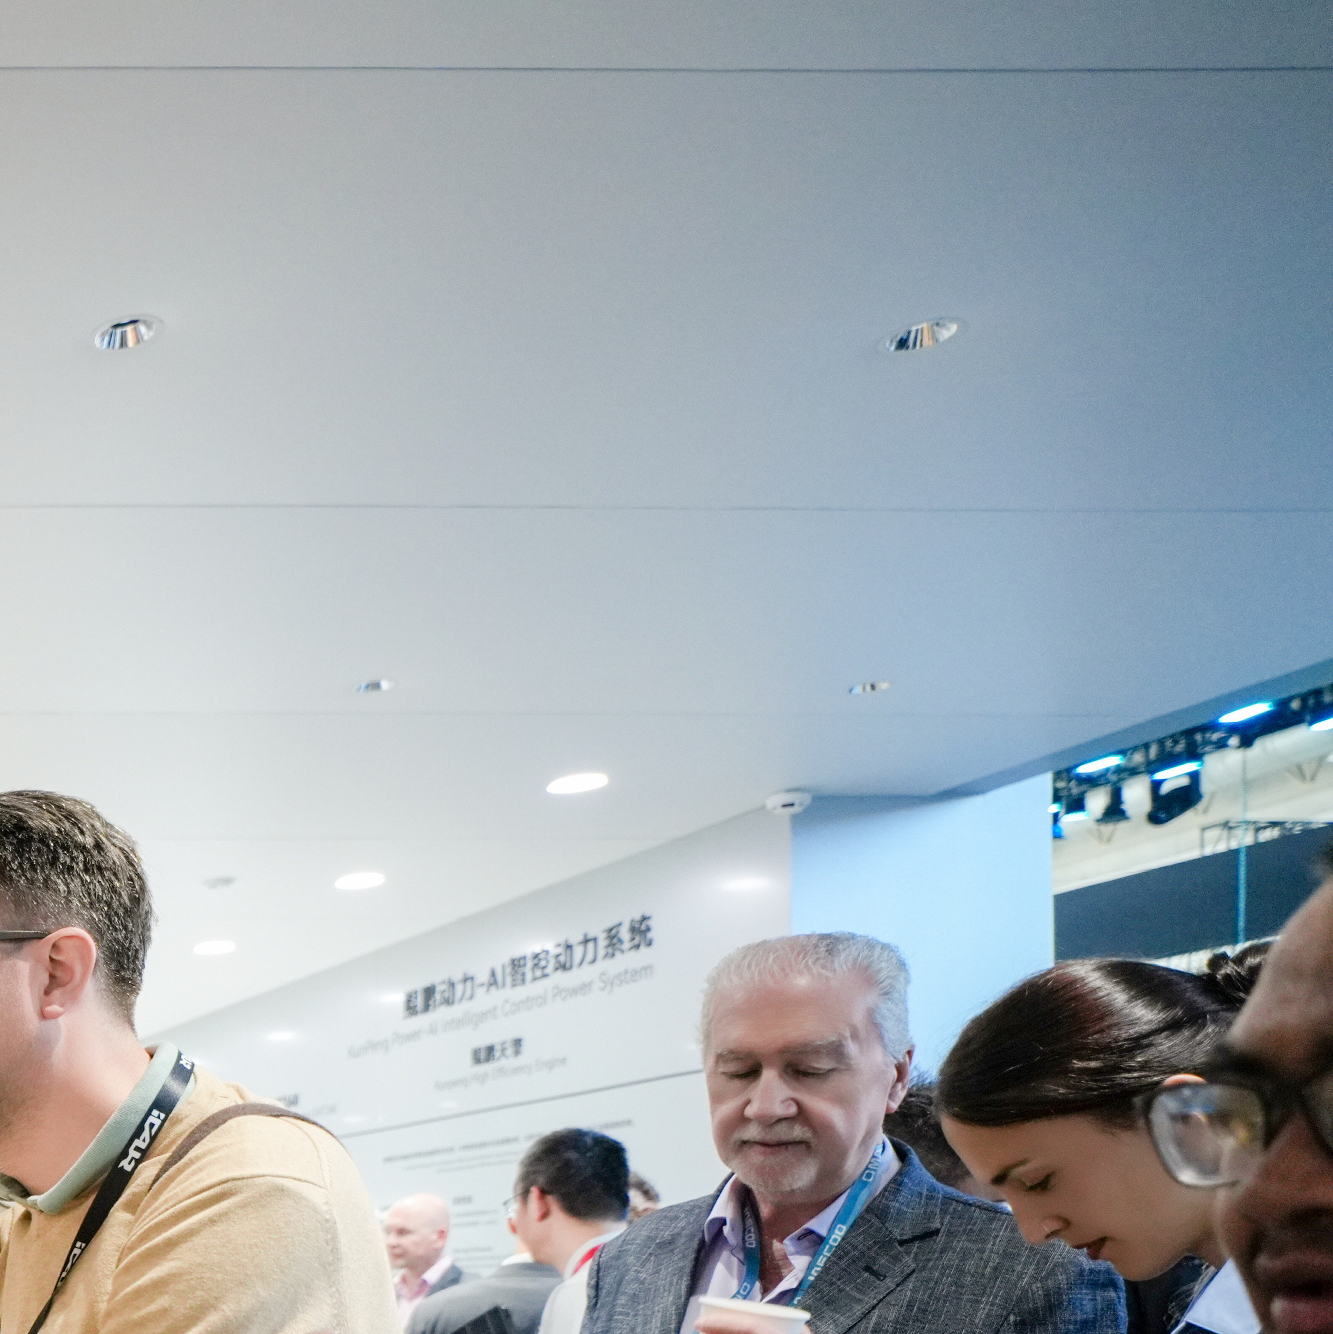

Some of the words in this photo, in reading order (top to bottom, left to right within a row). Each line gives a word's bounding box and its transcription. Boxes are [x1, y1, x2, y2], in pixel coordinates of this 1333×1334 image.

[501, 991, 547, 1018] Control
[551, 980, 593, 1004] Power
[598, 964, 654, 995] System
